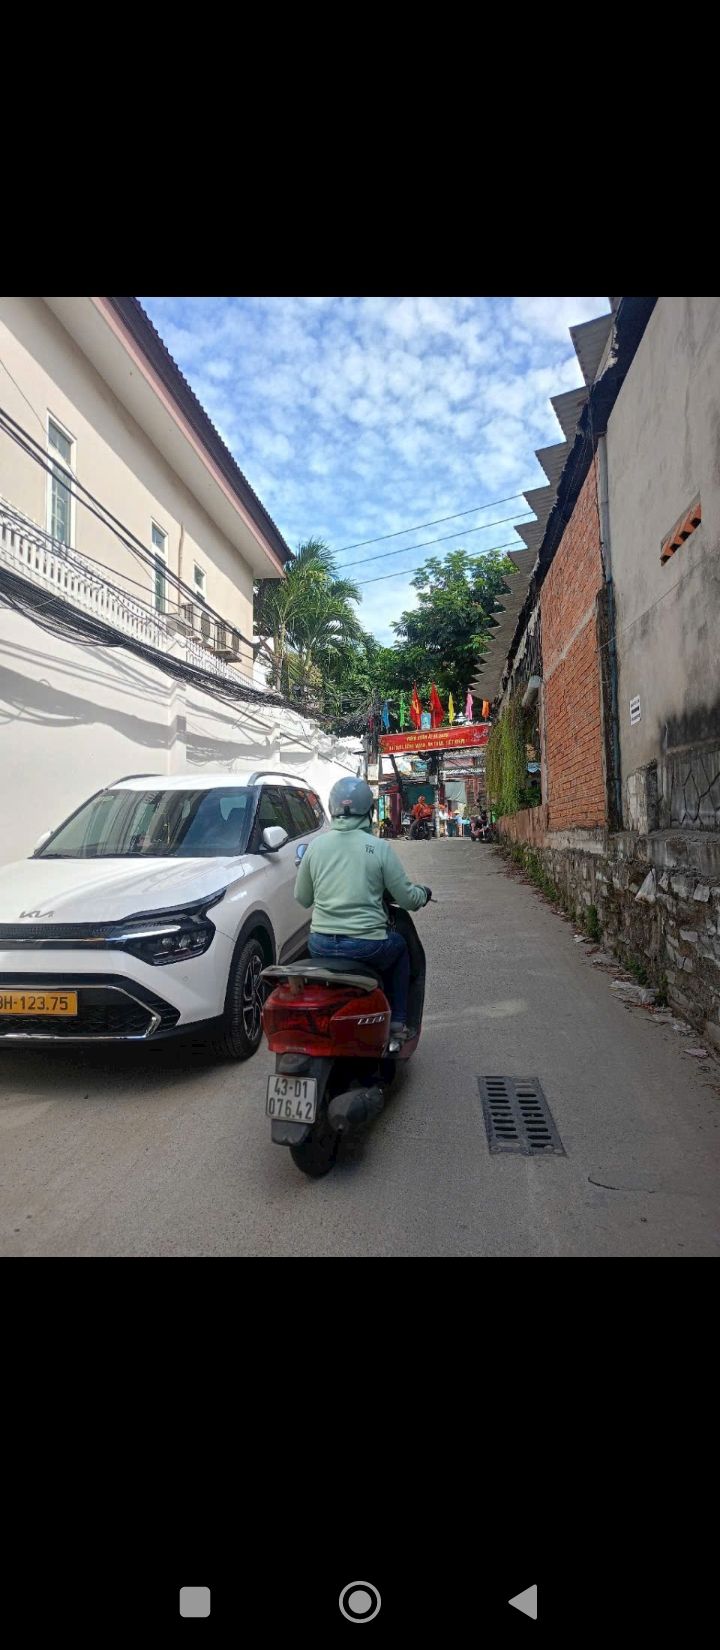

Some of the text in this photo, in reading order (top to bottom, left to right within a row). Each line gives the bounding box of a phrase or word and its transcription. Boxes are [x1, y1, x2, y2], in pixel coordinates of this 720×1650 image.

[19, 910, 56, 918] KIA
[274, 1078, 308, 1099] 43-D1
[268, 1098, 313, 1120] 076.42
